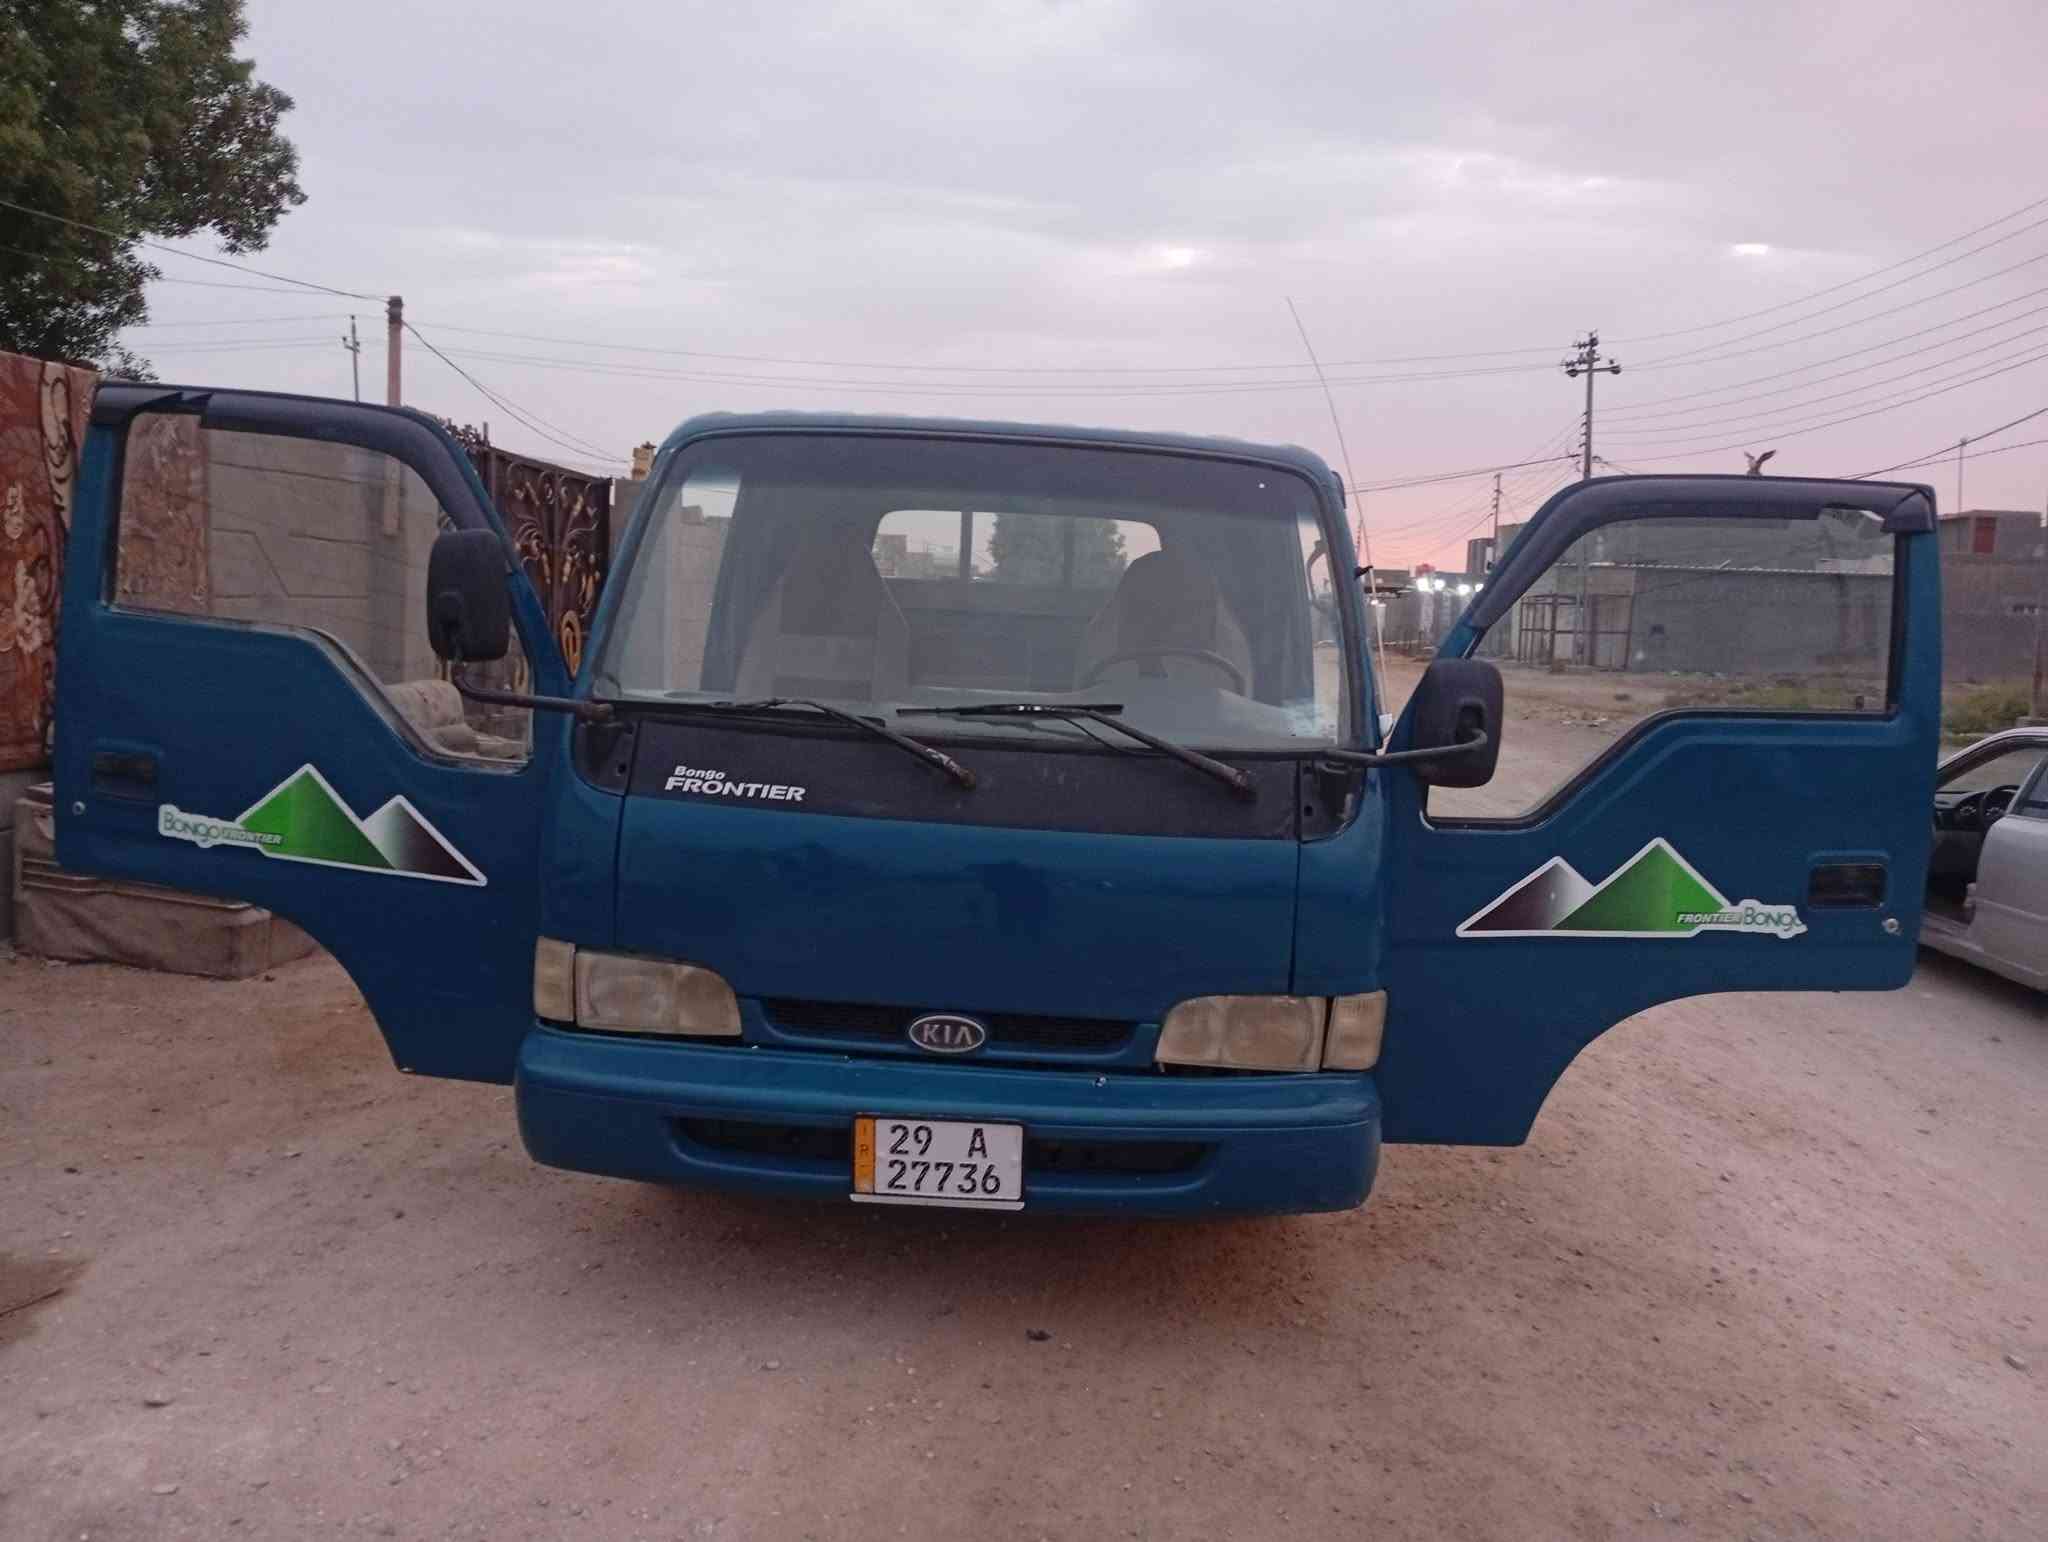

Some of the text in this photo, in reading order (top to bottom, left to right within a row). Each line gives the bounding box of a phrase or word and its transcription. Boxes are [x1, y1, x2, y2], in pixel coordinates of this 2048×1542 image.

[674, 765, 726, 780] Bongo
[664, 776, 806, 801] FRONTIER
[923, 1023, 973, 1045] KIA
[889, 1124, 988, 1158] 29 A
[887, 1159, 1001, 1194] 27736
